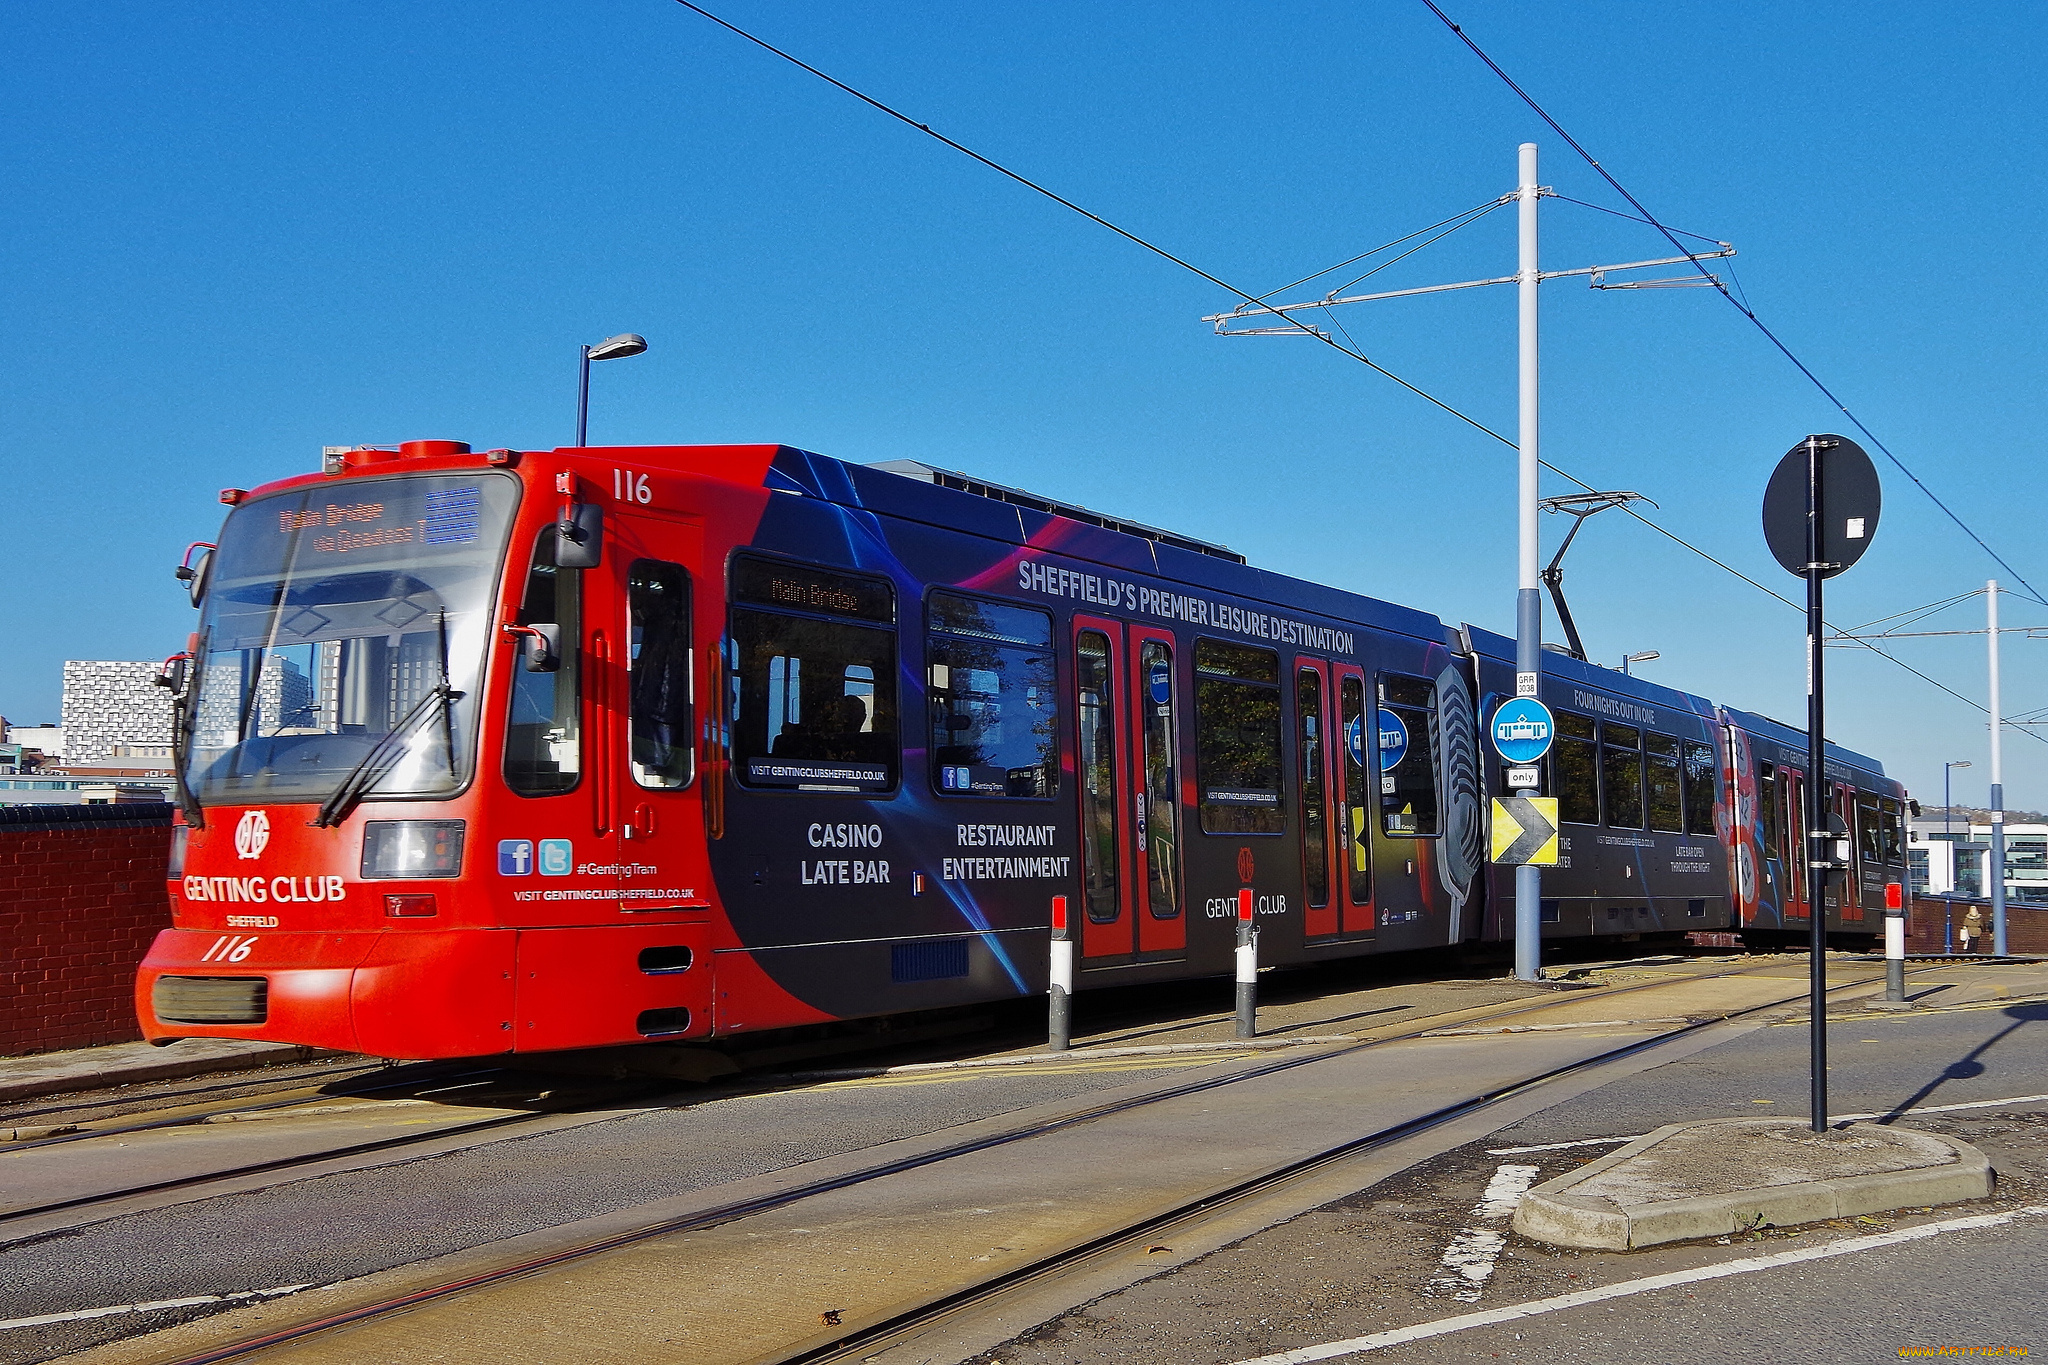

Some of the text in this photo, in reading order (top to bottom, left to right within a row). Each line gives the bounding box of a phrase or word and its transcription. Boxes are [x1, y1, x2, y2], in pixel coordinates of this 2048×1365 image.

[614, 468, 652, 504] 116
[326, 502, 385, 526] Bridge
[772, 577, 858, 611] Malin Bridge
[1018, 560, 1354, 655] SHEFFIELD'S PREMIER LEISURE DESTINATION
[1574, 689, 1656, 725] FOUR NIGHTS OUT IN ONE
[751, 765, 885, 781] VISIT GENTINGCLUBSHEFFIELD.CO.UK
[1513, 772, 1534, 783] only
[807, 823, 883, 848] CASINO
[957, 824, 1056, 847] RESTAURANT
[1560, 837, 1572, 850] THE
[577, 862, 657, 878] #GentingTram
[801, 860, 891, 885] LATE BAR
[942, 857, 1070, 880] ENTERTAINMENT
[183, 875, 347, 903] GENTING CLUB
[513, 888, 695, 901] VISIT GENTINGCLUBSHEFFIELD.CO.UK
[1258, 894, 1287, 915] CLUB
[226, 915, 280, 928] SHEFFIELD
[200, 935, 259, 963] 116
